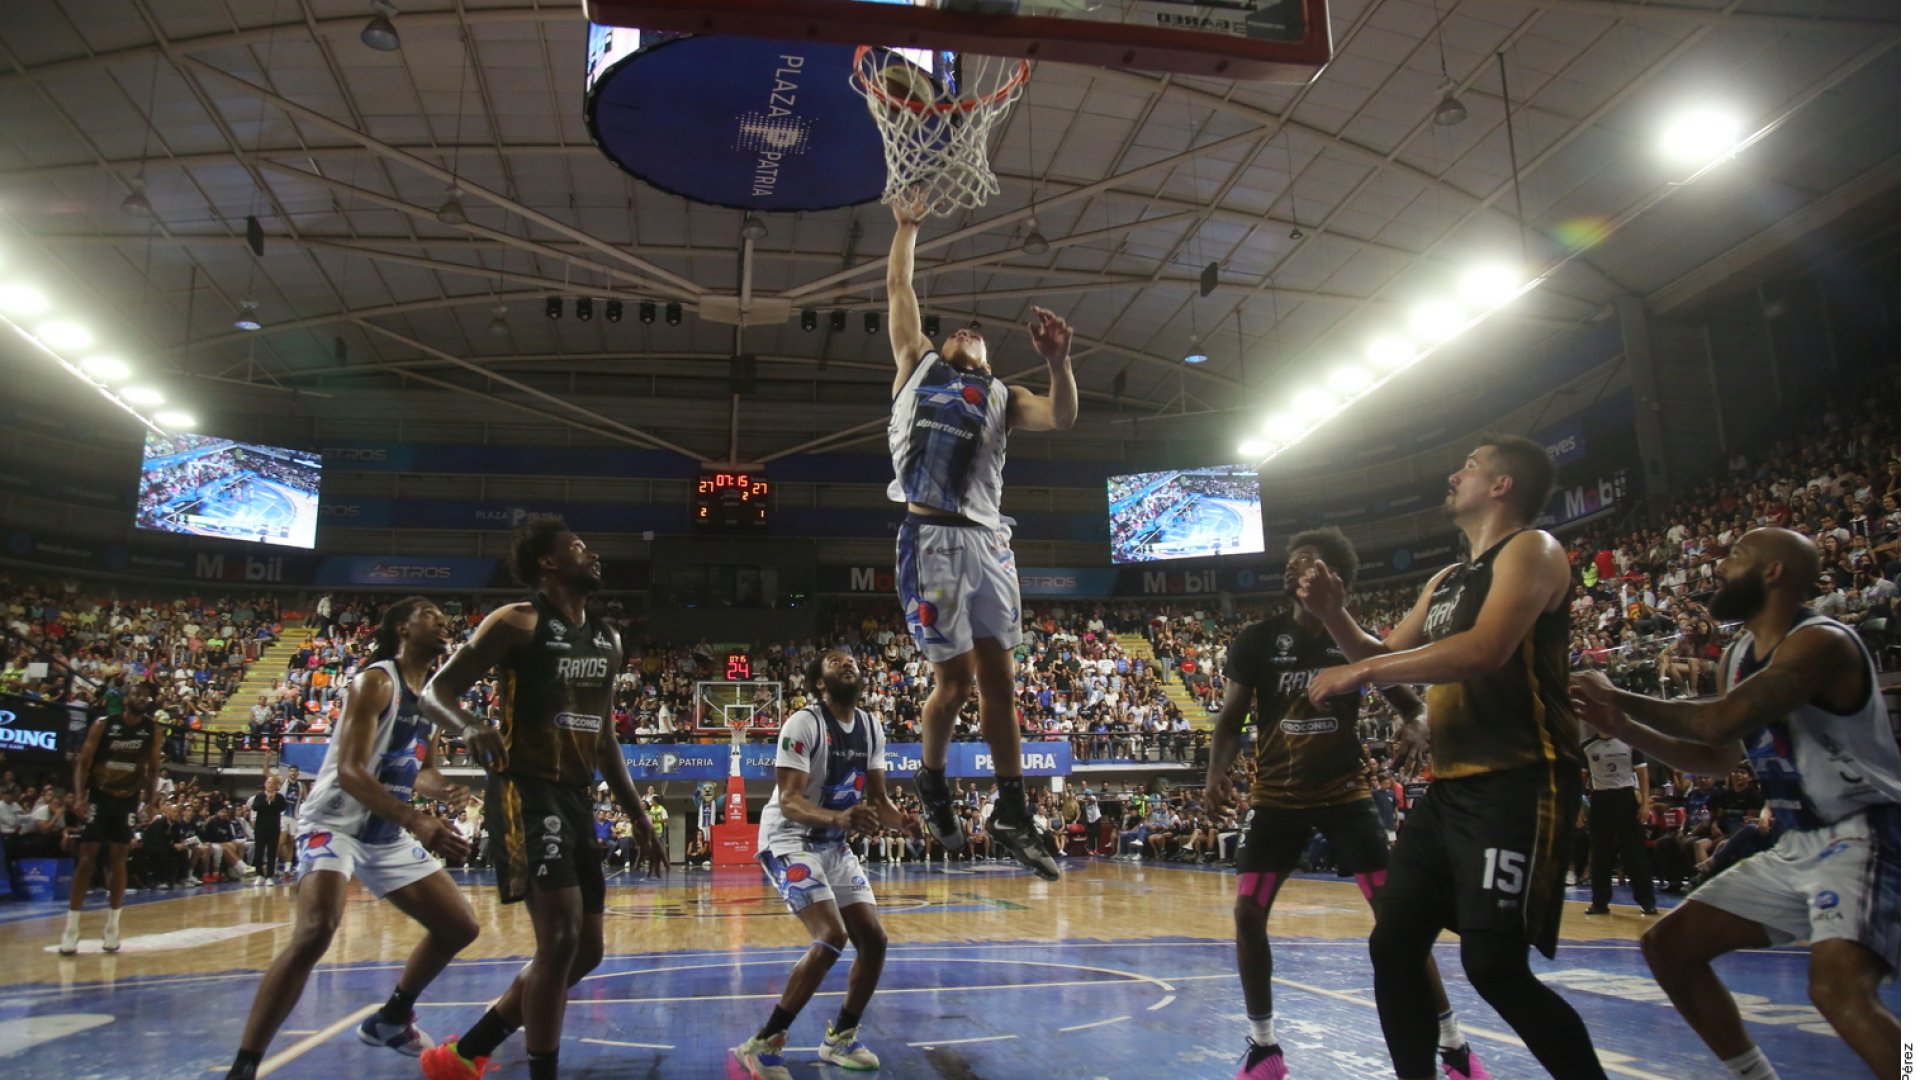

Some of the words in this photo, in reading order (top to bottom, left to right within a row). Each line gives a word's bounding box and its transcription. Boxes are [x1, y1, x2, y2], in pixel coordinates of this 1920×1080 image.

[768, 55, 804, 117] PLAZA
[752, 151, 782, 196] PATRIA
[916, 418, 974, 440] dportenis
[320, 447, 388, 461] STROS
[1546, 435, 1577, 460] eyes
[699, 481, 714, 493] 27
[716, 474, 748, 487] 07:15
[752, 482, 768, 494] 27
[742, 491, 749, 500] 2
[320, 504, 361, 518] ROS
[700, 507, 707, 517] 2
[367, 563, 452, 579] ASTROS
[1020, 575, 1078, 588] STROS
[1424, 586, 1466, 634] RAY
[557, 657, 608, 680] RAYOS
[726, 663, 749, 680] 24
[1279, 669, 1320, 694] RAY
[0, 727, 58, 751] DING
[626, 758, 659, 767] PLAZA
[679, 758, 714, 767] PATRIA
[127, 812, 137, 827] 6
[1482, 847, 1526, 894] 15
